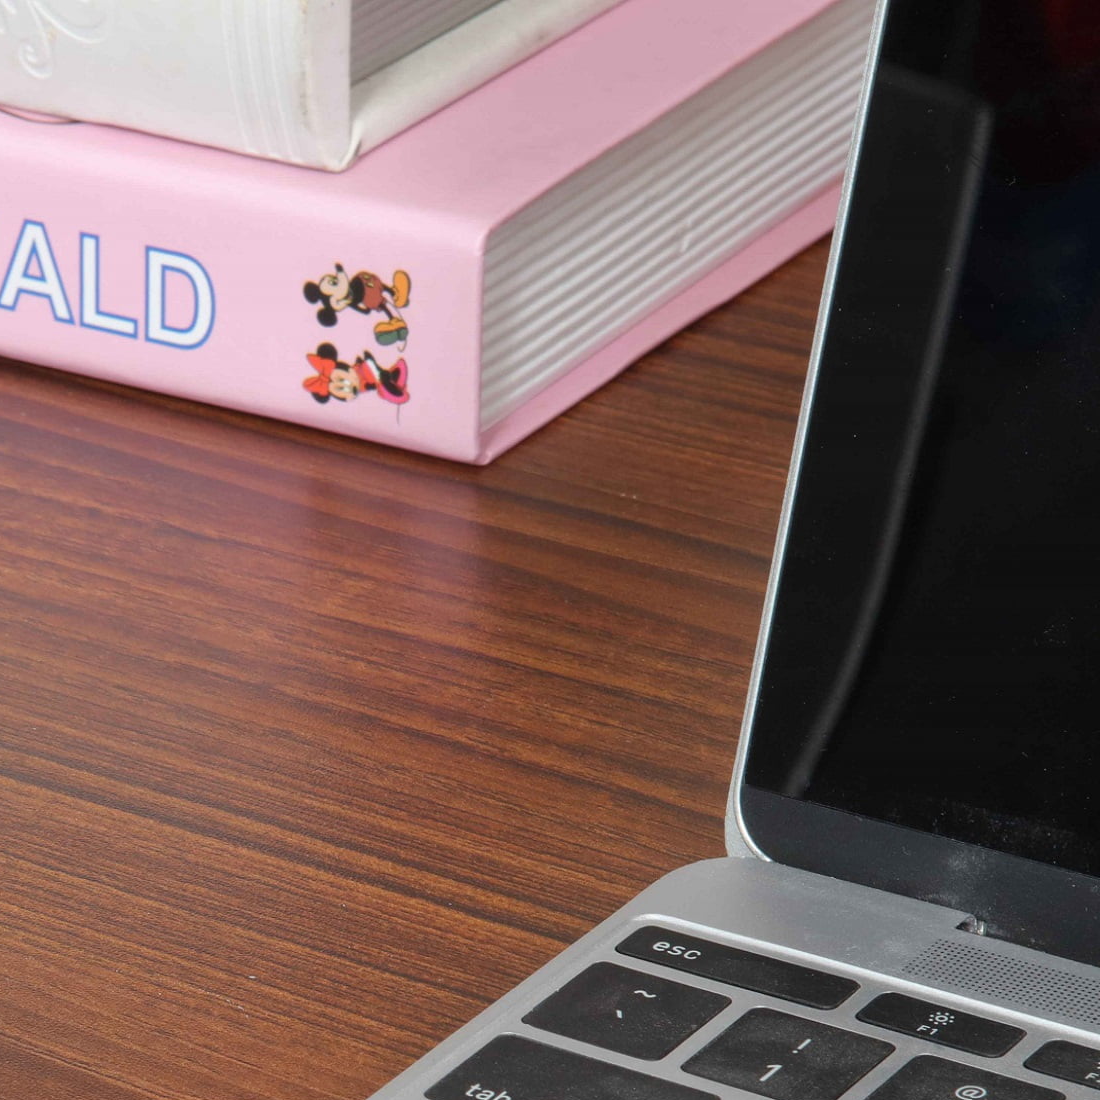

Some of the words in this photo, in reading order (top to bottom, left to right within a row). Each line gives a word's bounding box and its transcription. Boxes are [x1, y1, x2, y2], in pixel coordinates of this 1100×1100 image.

[652, 941, 702, 960] esc
[916, 1024, 939, 1035] F1
[759, 1064, 783, 1082] 1
